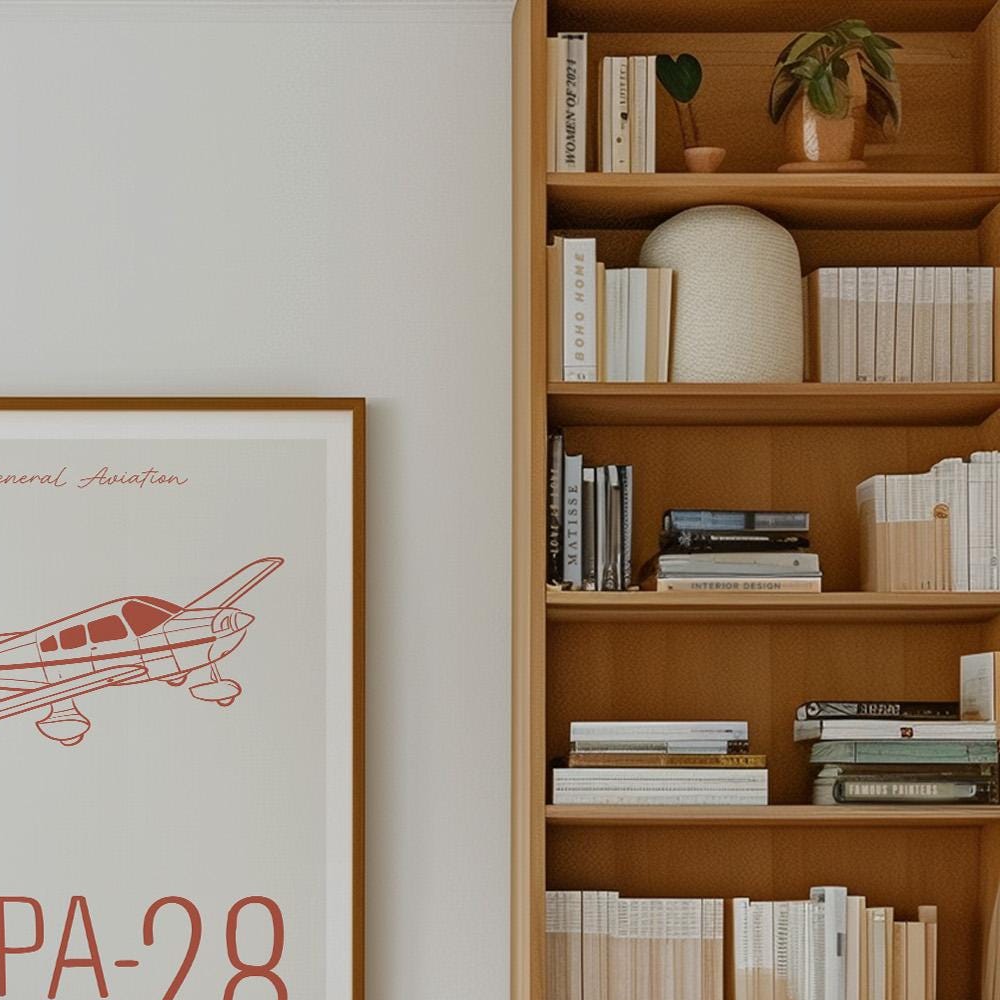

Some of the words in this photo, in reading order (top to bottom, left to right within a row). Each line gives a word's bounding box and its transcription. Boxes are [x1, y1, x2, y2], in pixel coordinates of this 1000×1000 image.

[565, 58, 577, 87] 2024
[565, 88, 577, 108] OF
[564, 110, 576, 165] WOMEN
[574, 253, 585, 302] HOME
[574, 312, 585, 361] BOHO
[77, 466, 189, 489] Aviation
[567, 484, 578, 566] MATISSE
[690, 581, 740, 590] INTERIOR
[743, 581, 782, 590] DESIGN
[849, 783, 889, 796] FAMOUS
[892, 783, 938, 796] PAINTERS
